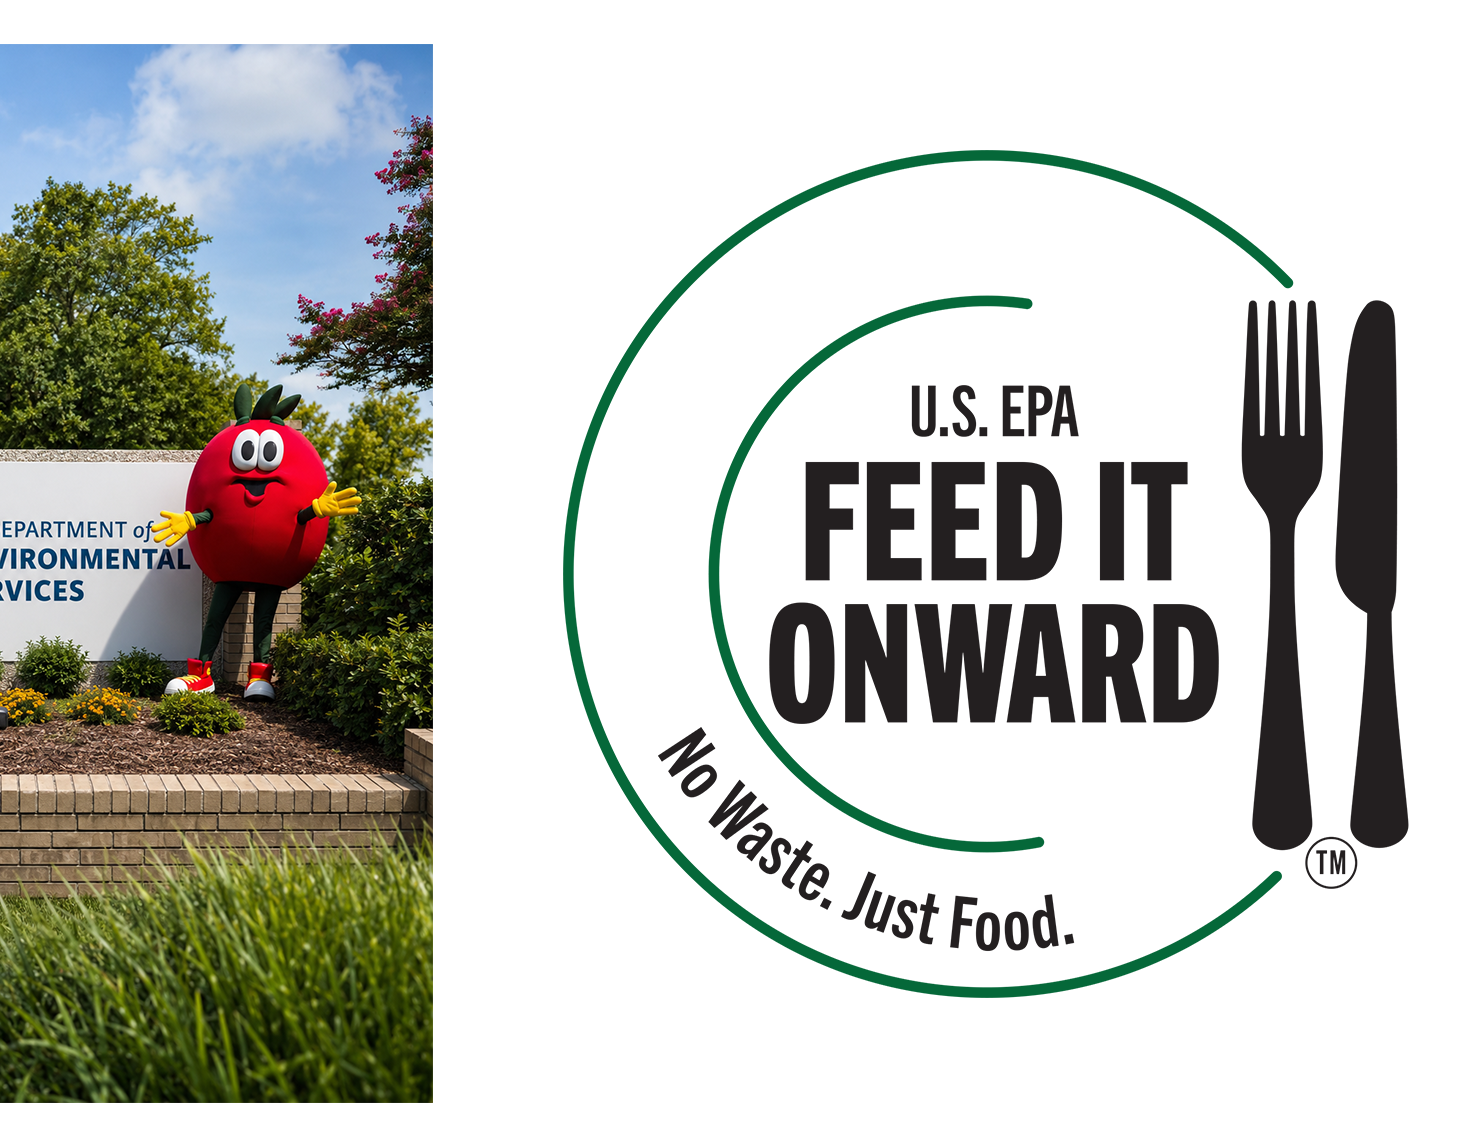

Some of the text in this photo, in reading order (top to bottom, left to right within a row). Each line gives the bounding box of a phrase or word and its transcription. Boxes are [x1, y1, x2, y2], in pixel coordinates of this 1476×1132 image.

[910, 384, 1079, 438] U.S. EPA
[133, 520, 154, 543] of
[804, 461, 1189, 581] FEED IT
[767, 601, 1220, 725] ONWARD
[658, 726, 1075, 952] No Waste. Just Food.
[1316, 850, 1346, 875] TM
